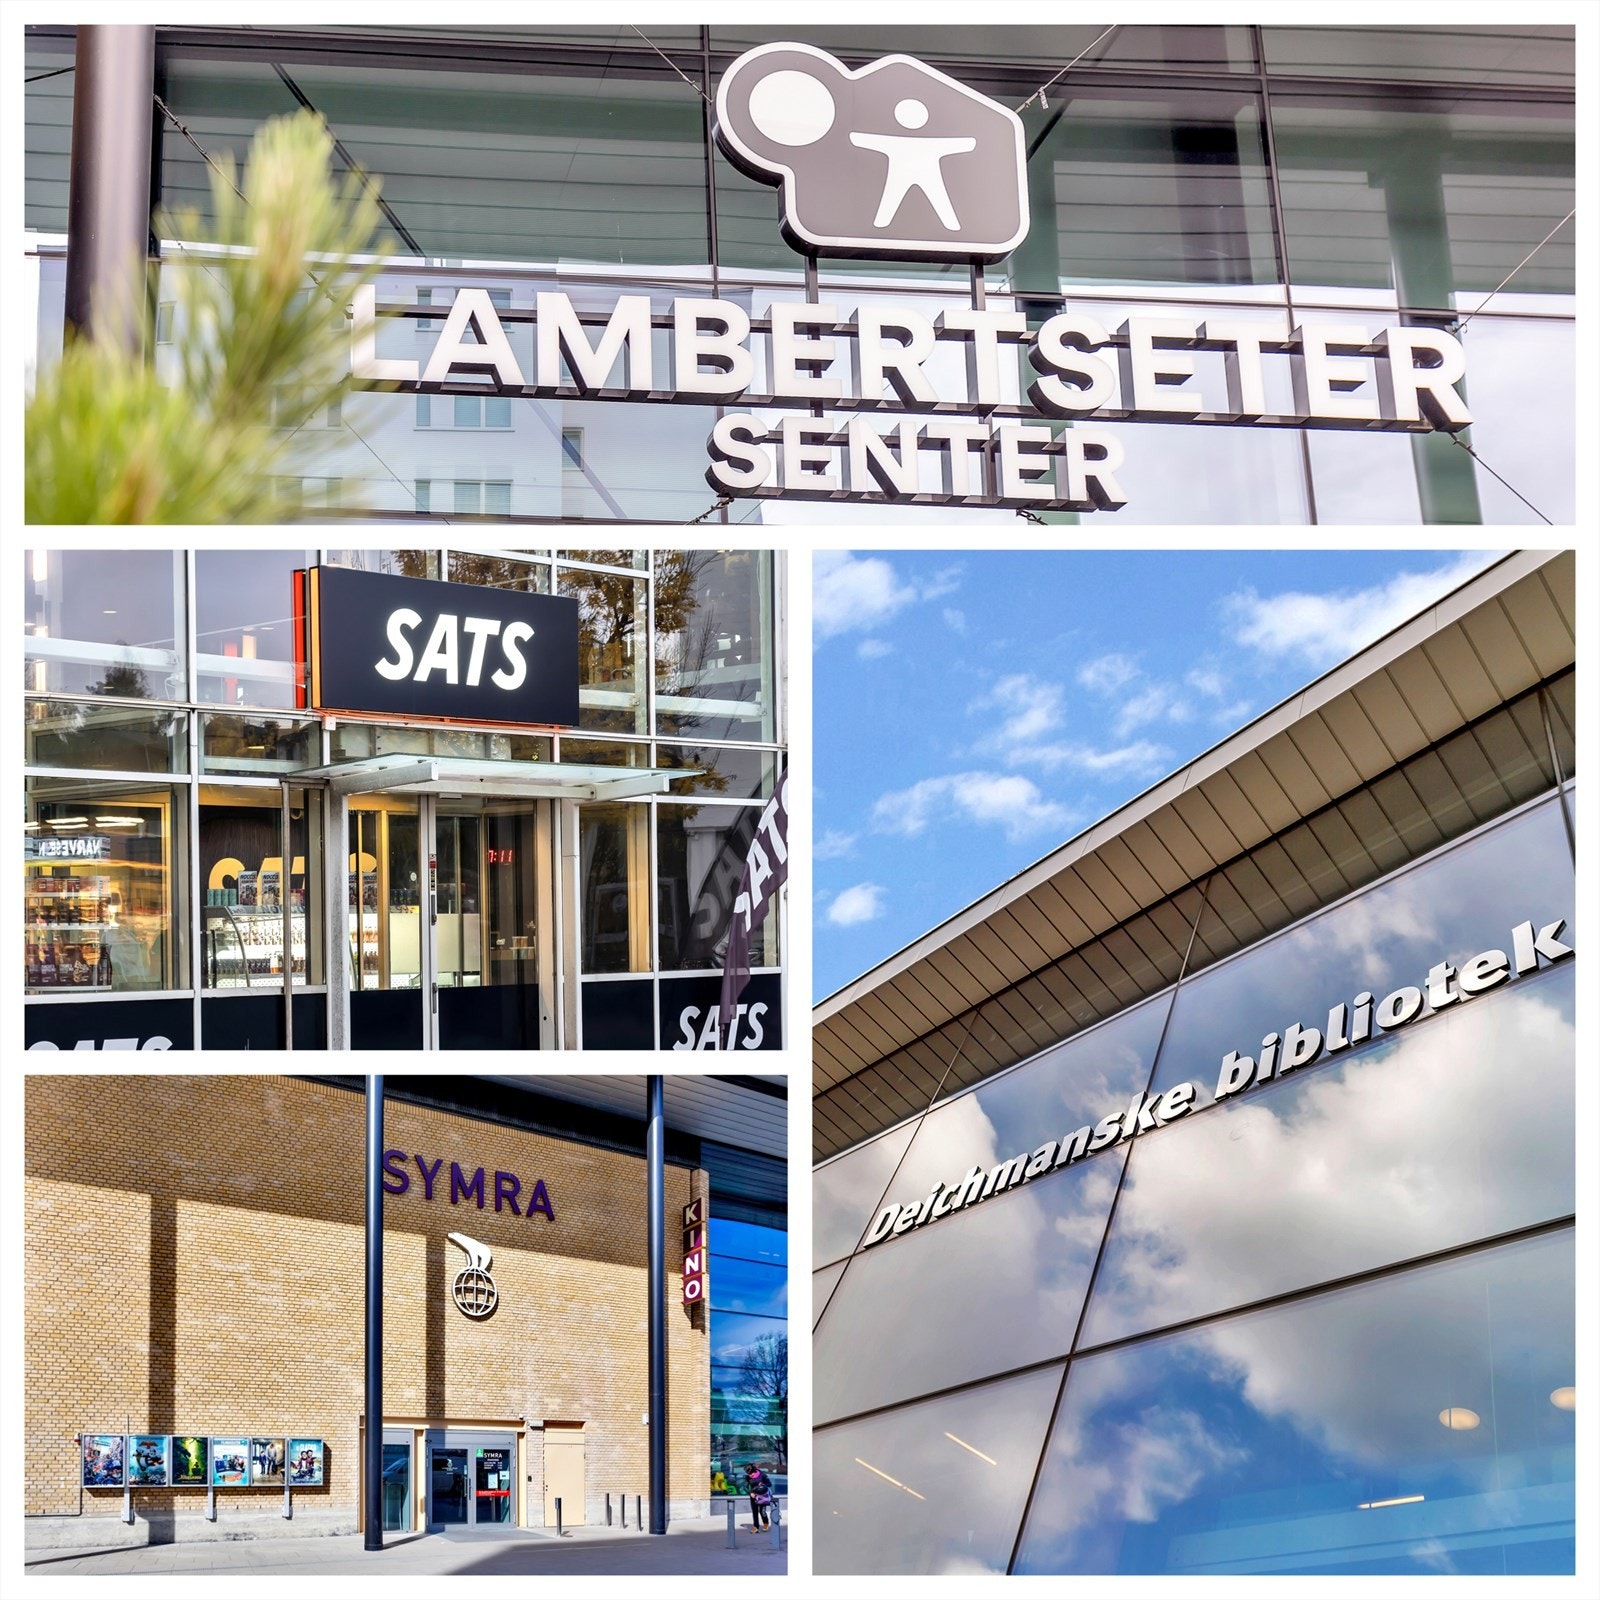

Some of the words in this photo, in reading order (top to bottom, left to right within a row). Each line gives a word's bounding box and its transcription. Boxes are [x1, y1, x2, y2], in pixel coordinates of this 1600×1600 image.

[351, 284, 1472, 430] LAMBERTSETER
[707, 412, 1127, 508] SENTER
[375, 607, 535, 691] SATS
[672, 1002, 768, 1050] SATS
[863, 1078, 1197, 1250] Deichmanske
[1214, 919, 1575, 1101] bibliotek
[383, 1149, 555, 1222] SYMRA
[685, 1203, 701, 1299] KINO
